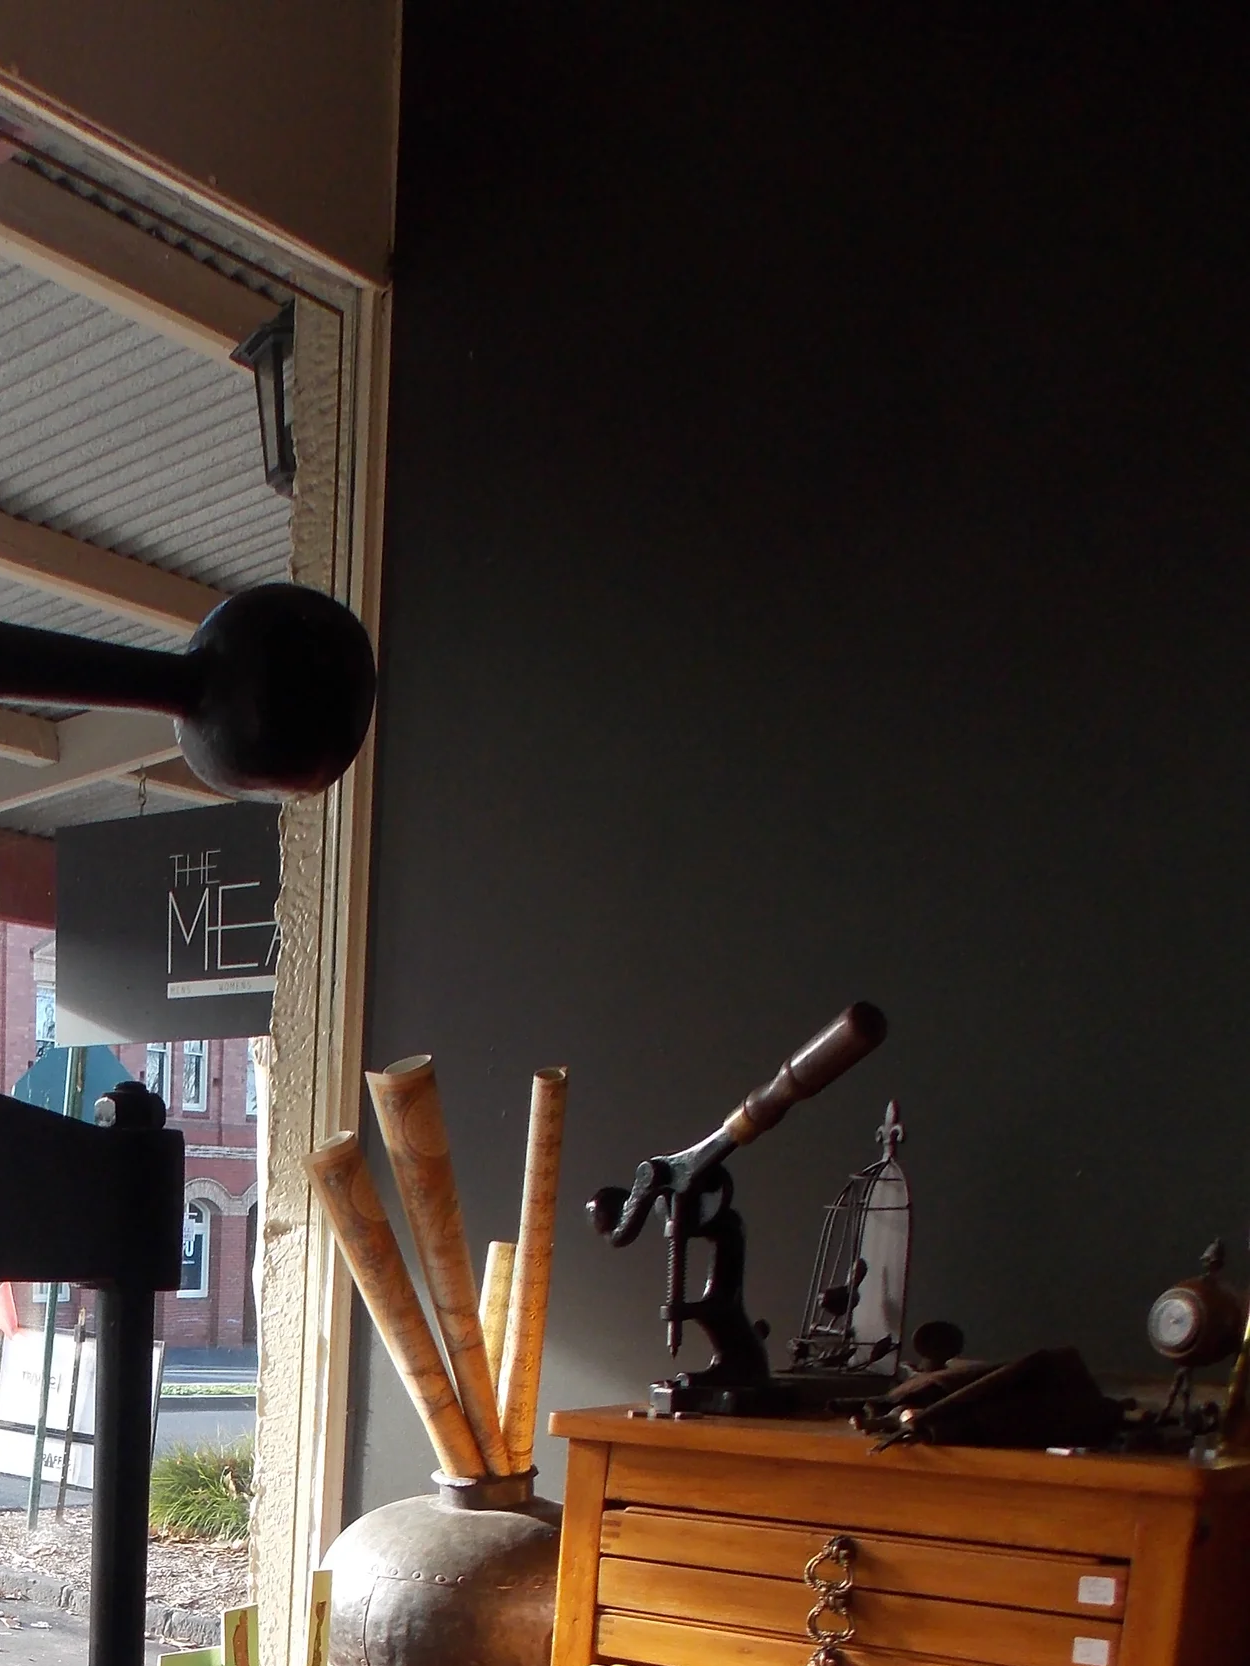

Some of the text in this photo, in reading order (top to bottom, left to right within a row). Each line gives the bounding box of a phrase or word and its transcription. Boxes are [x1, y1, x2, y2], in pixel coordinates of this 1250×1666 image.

[169, 850, 221, 887] THE
[170, 980, 252, 995] MENS WOMENS
